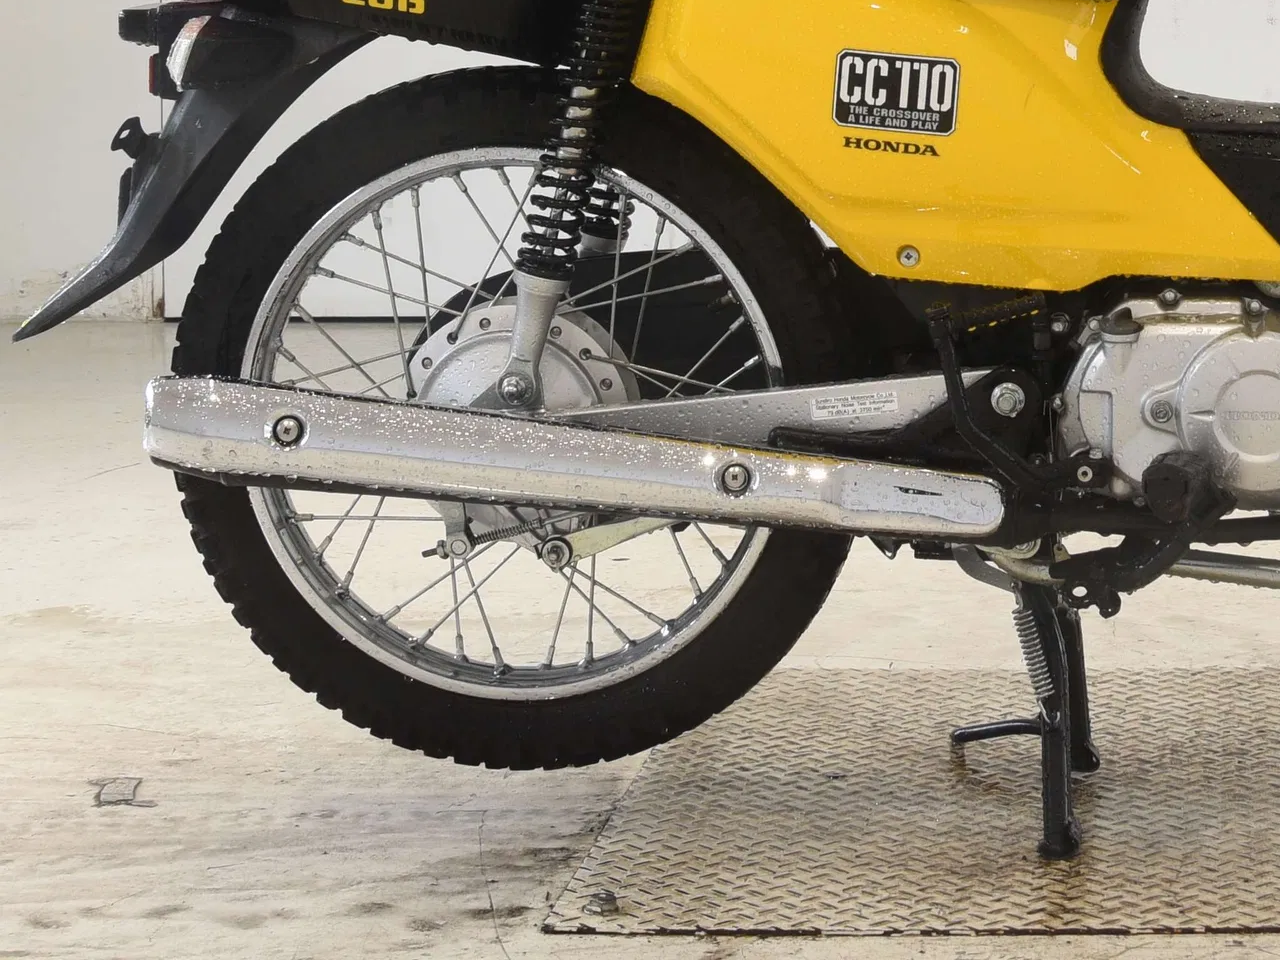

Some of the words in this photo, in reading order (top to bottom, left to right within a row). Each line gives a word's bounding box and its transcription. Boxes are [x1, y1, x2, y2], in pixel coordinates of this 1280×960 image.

[839, 56, 889, 106] CC
[847, 114, 856, 123] A
[859, 115, 881, 126] LIFE
[884, 118, 908, 128] AND
[911, 120, 939, 130] PLAY
[849, 105, 869, 115] THE
[873, 107, 940, 122] CROSSOVER
[843, 136, 940, 157] HONDA
